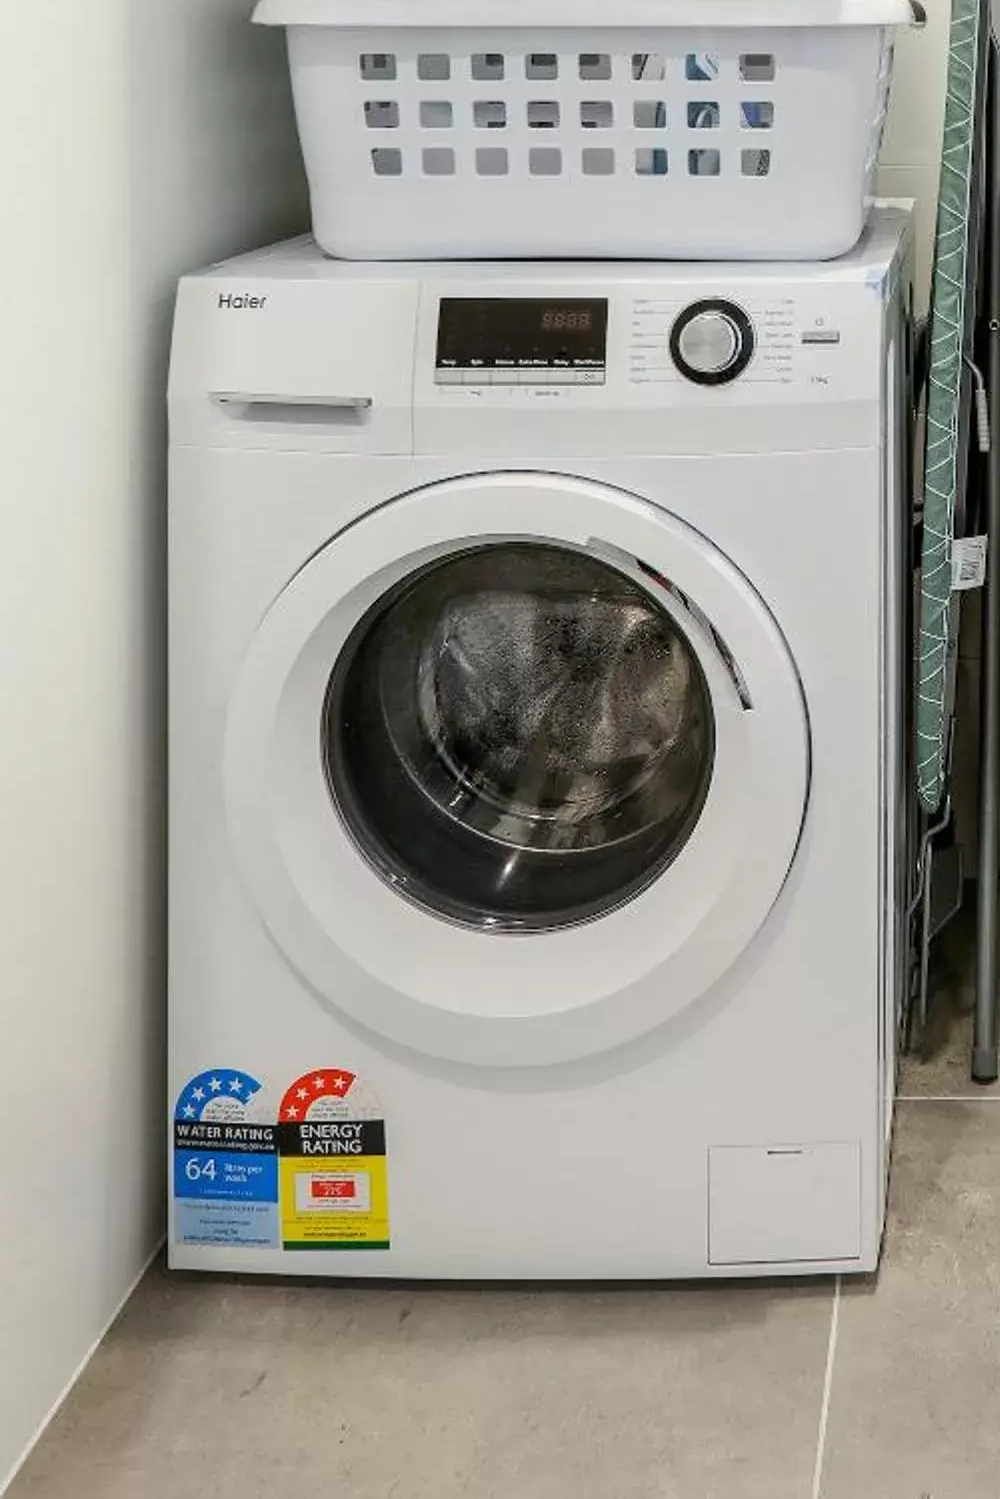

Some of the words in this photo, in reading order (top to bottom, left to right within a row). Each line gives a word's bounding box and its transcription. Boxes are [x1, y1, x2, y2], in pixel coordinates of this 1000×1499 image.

[217, 292, 267, 309] Haier
[177, 1124, 222, 1140] WATER
[226, 1127, 273, 1142] RATING
[299, 1124, 363, 1139] ENERGY
[302, 1139, 363, 1154] RATING
[185, 1157, 217, 1181] 64
